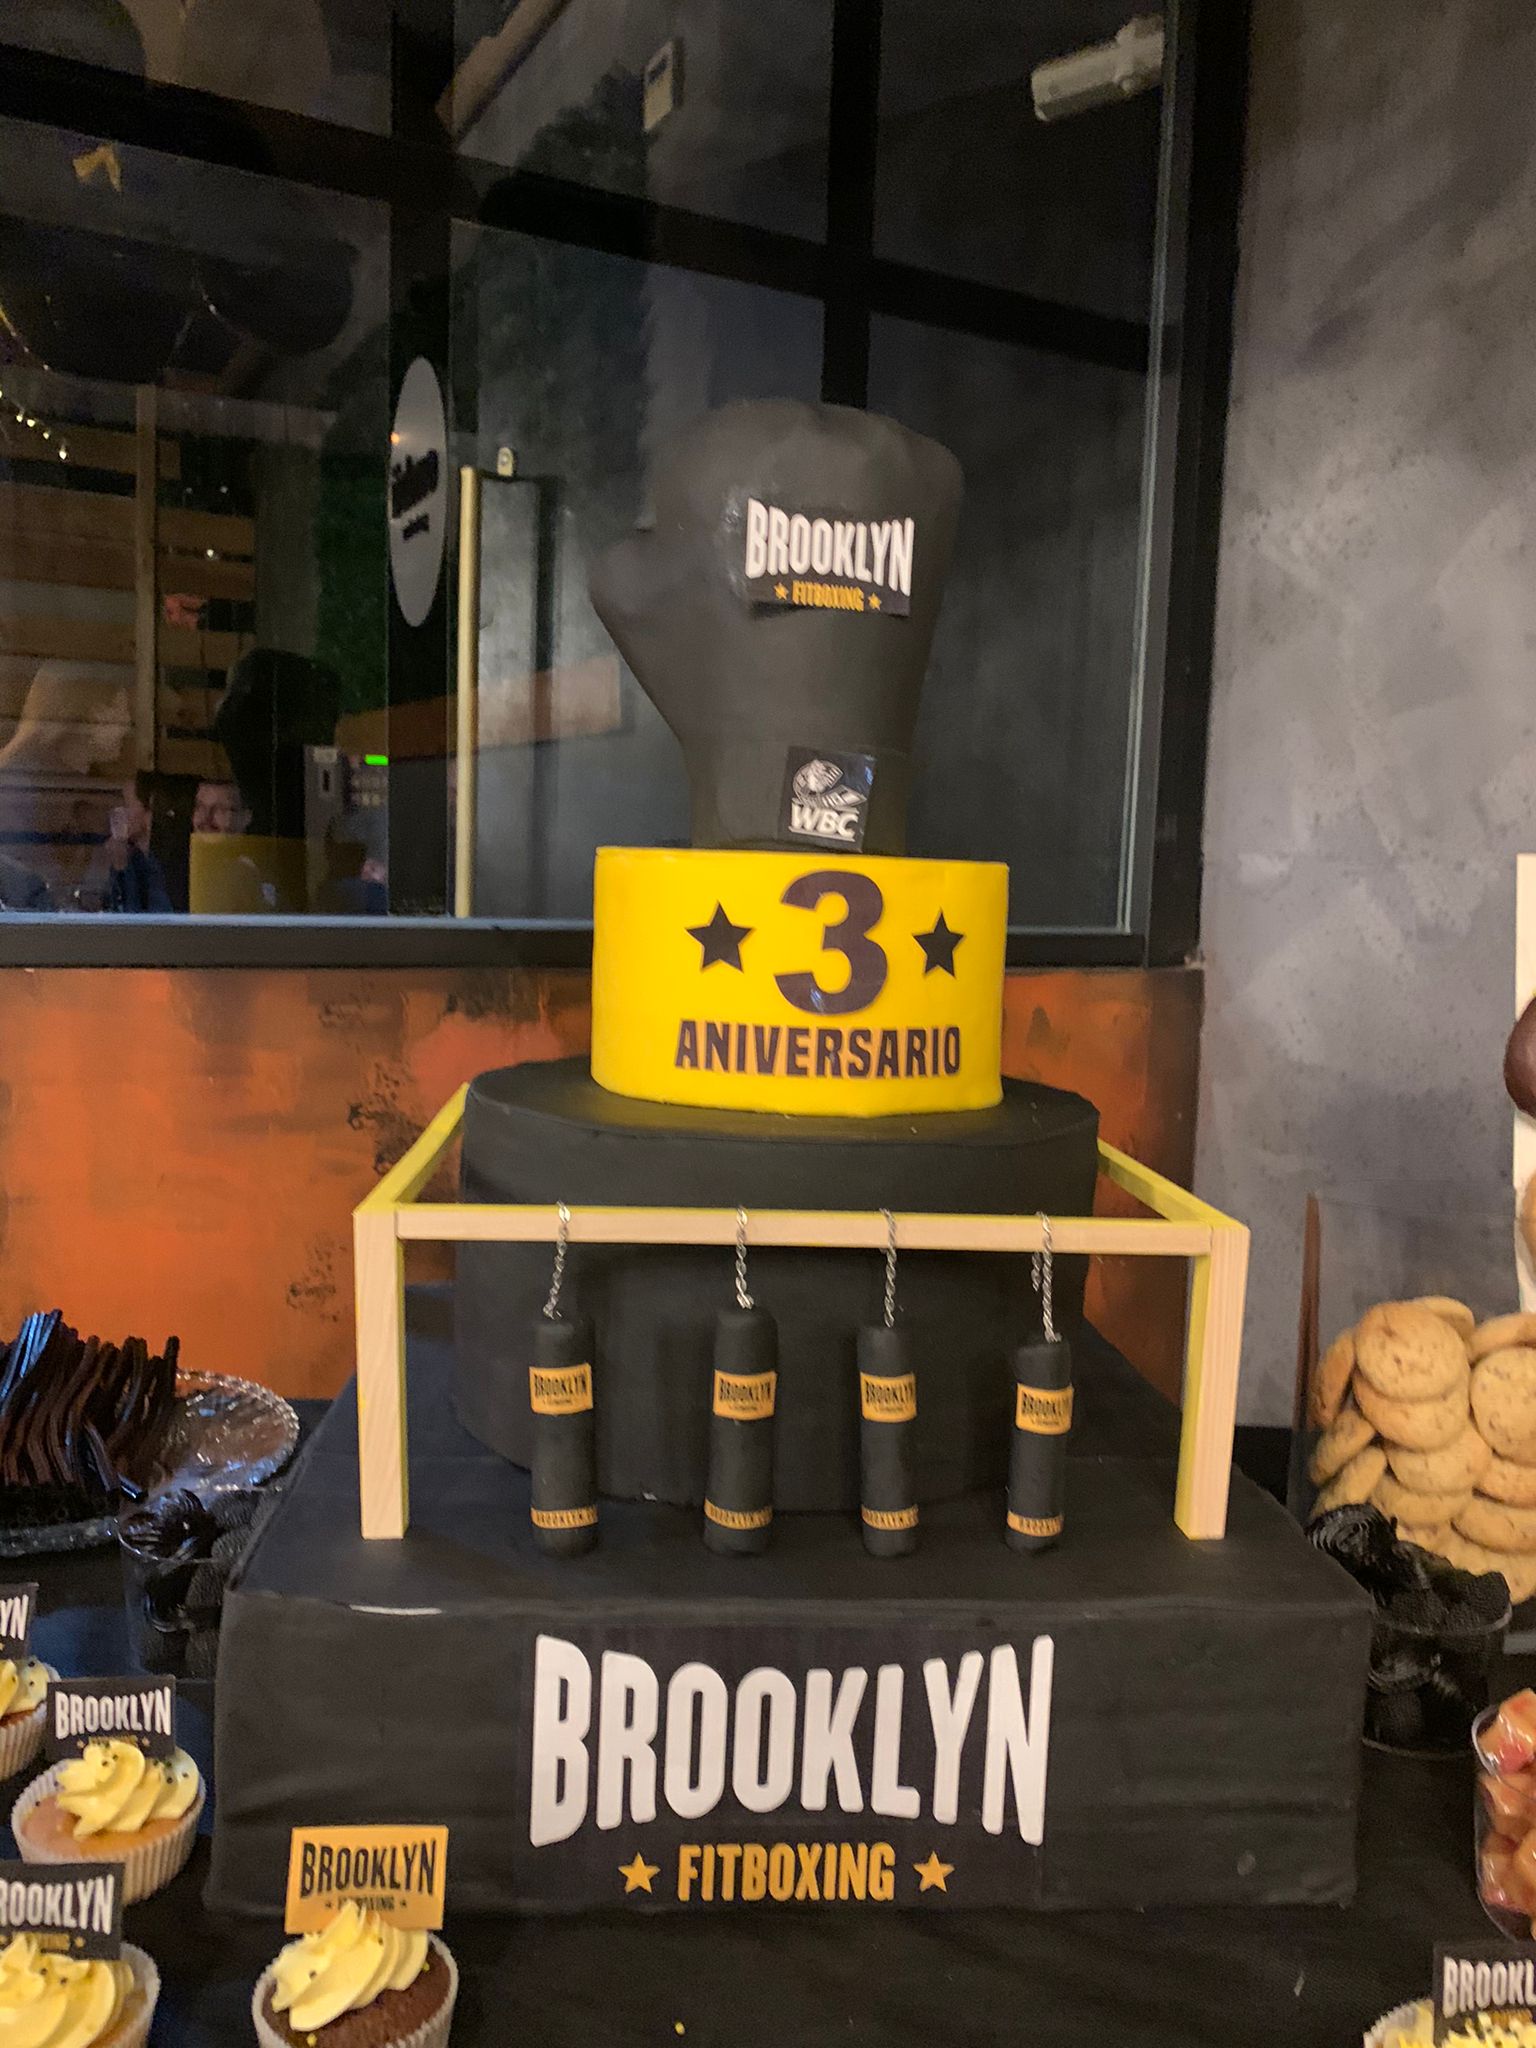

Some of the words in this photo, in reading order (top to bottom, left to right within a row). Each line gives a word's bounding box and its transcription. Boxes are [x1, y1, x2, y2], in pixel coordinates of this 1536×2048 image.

[745, 497, 915, 597] BROOKLYN
[790, 798, 859, 839] WBC
[773, 869, 888, 1016] 3
[674, 1018, 961, 1079] ANIVERSARIO
[534, 1372, 588, 1399] BROOKLYN
[55, 1685, 172, 1740] BROOKLYN
[530, 1633, 1054, 1848] BROOKLYN
[300, 1837, 437, 1900] BROOKLYN
[677, 1841, 896, 1902] FITBOXING
